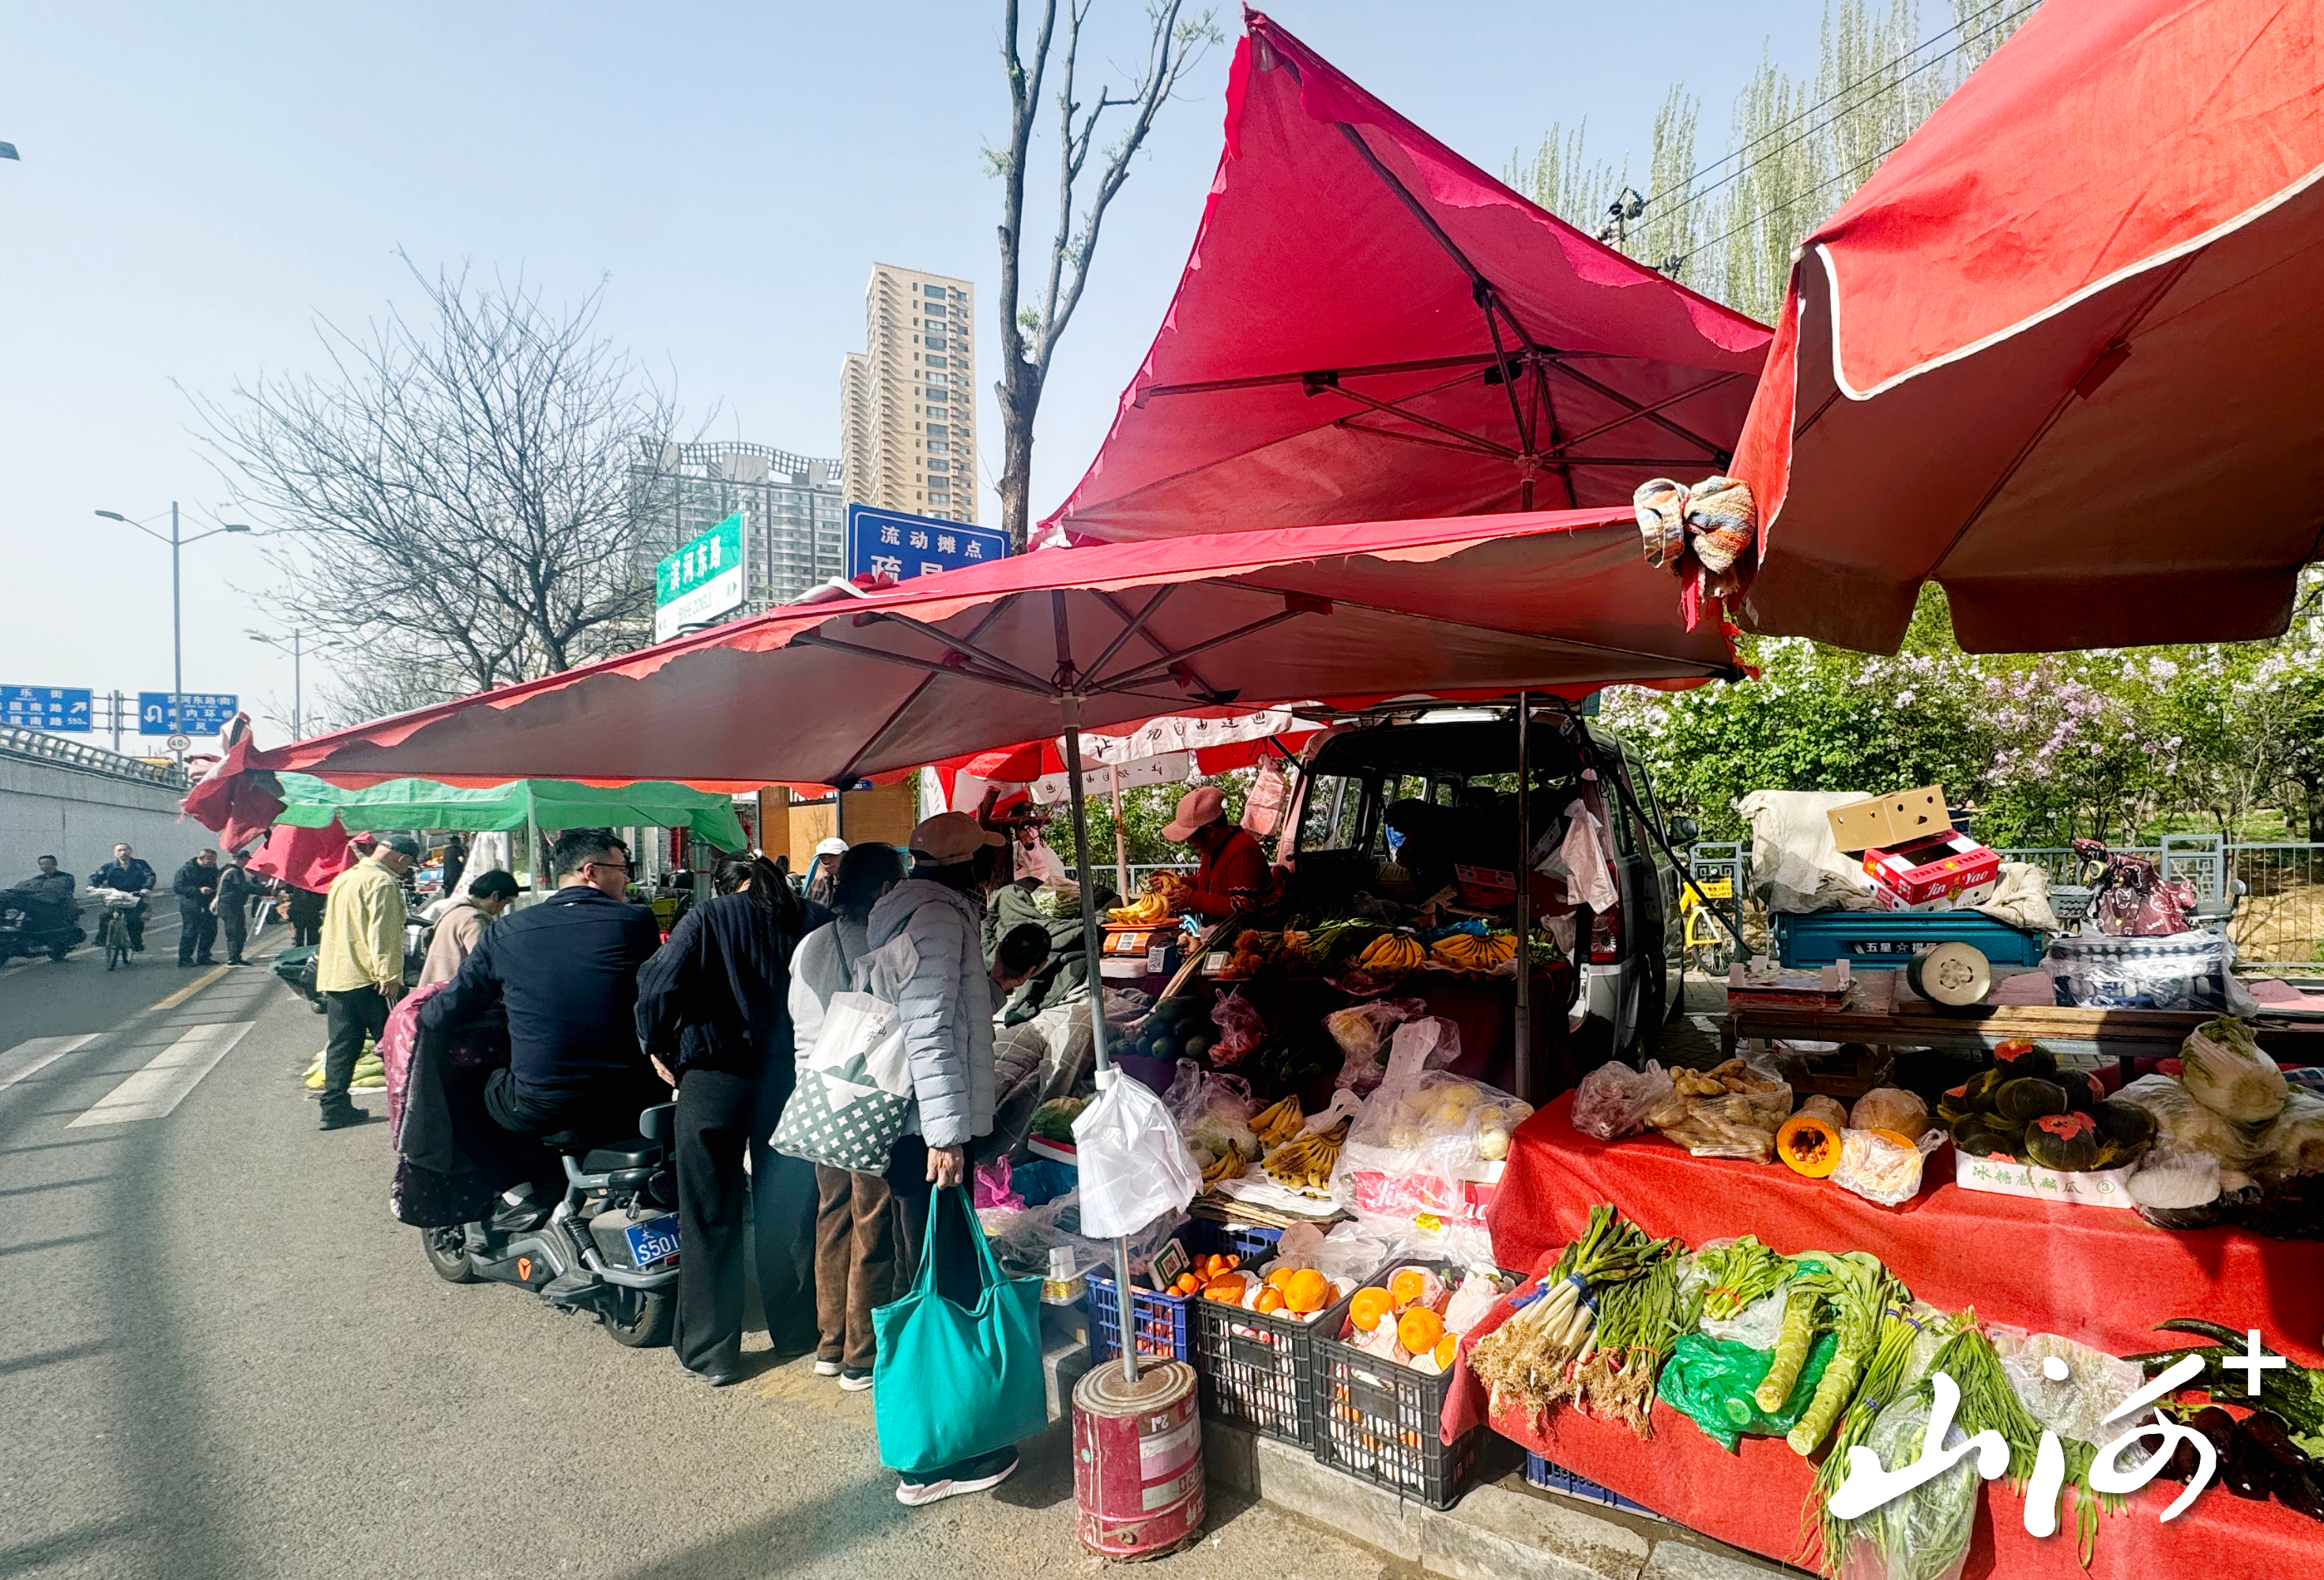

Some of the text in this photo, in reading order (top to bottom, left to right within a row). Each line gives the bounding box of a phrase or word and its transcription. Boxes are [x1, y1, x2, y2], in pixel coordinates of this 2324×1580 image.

[880, 525, 983, 559] 流动摊点
[670, 533, 722, 592] 滨河东路
[0, 687, 63, 699] 乐街
[1923, 882, 1947, 900] Jin
[1961, 869, 1990, 886] Yao
[1866, 942, 1893, 953] 五星
[1972, 1164, 2084, 1194] 冰糖麒麟瓜
[638, 1232, 682, 1262] S501
